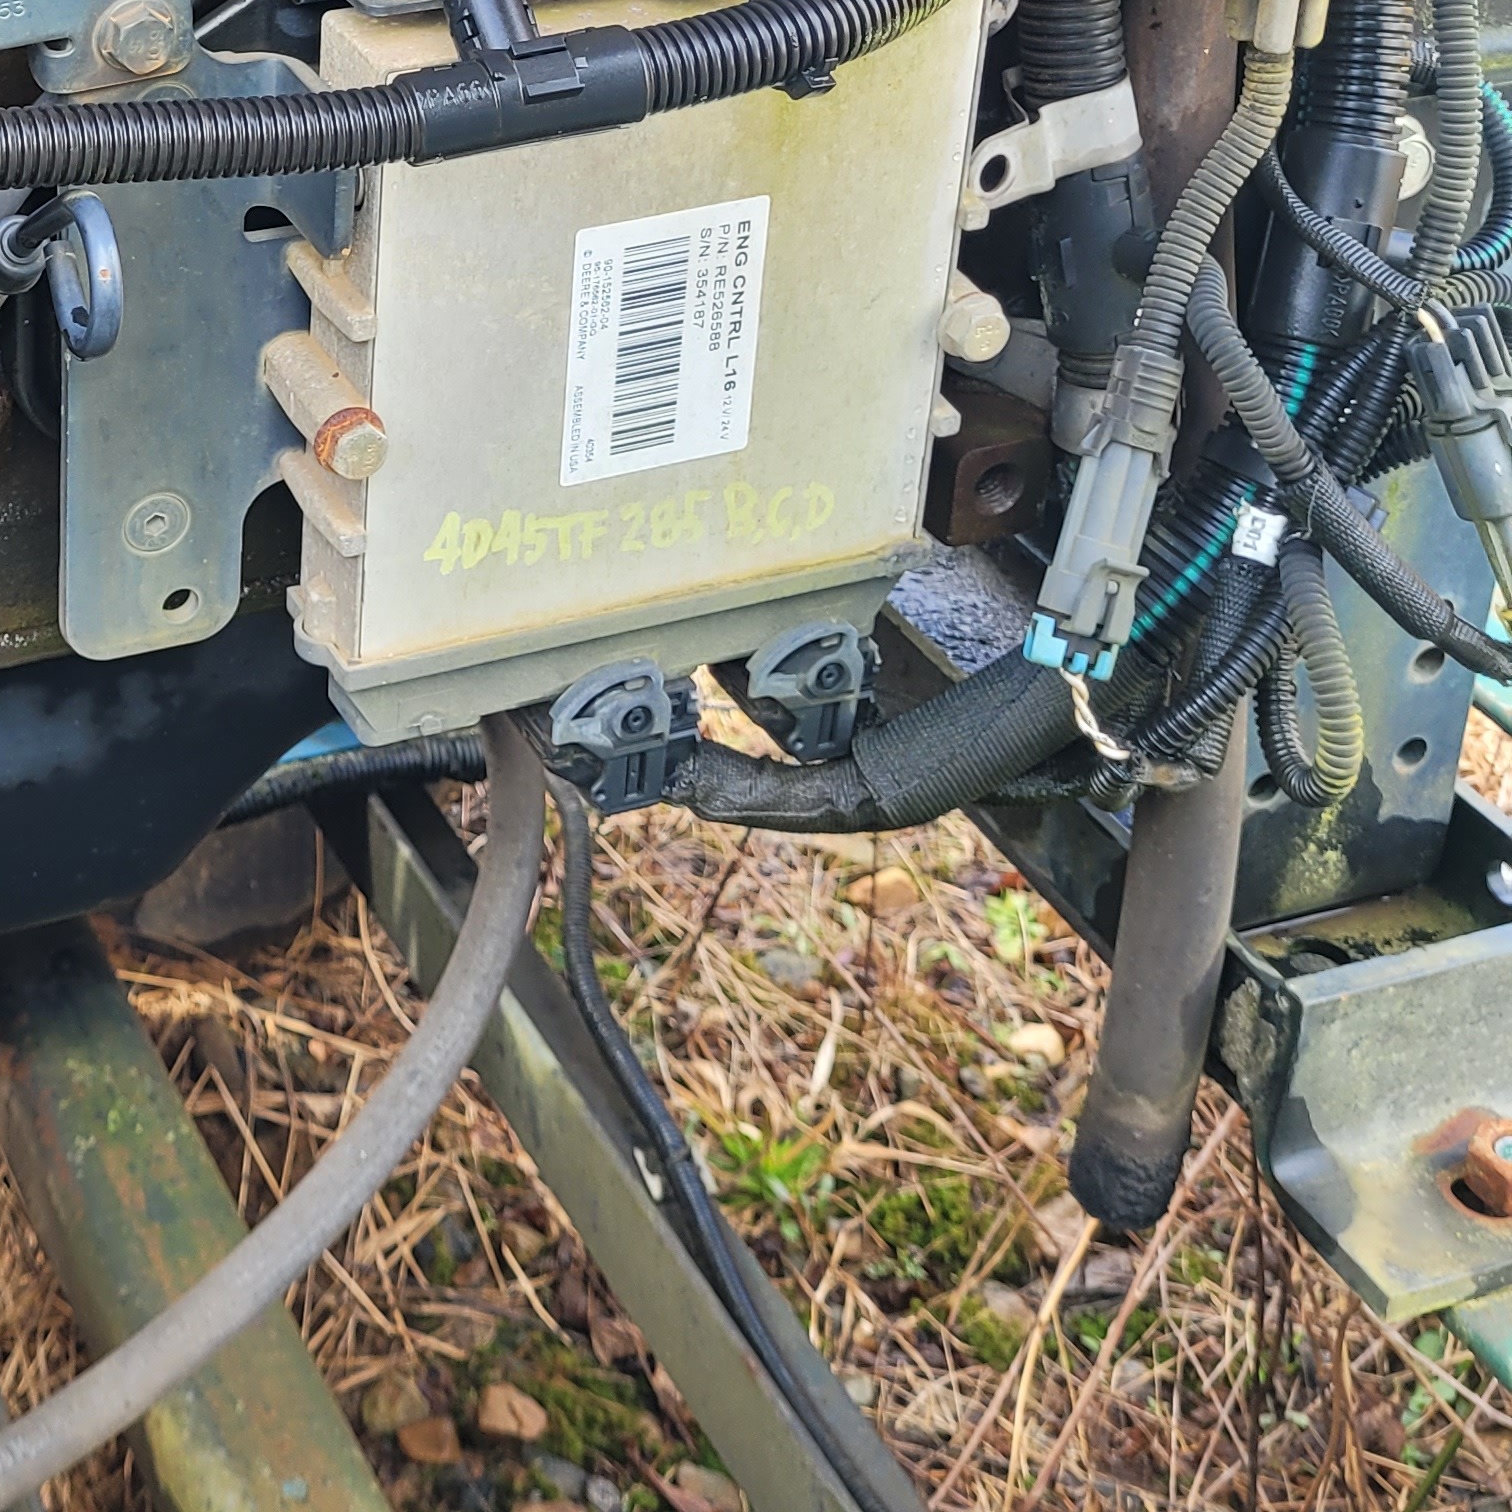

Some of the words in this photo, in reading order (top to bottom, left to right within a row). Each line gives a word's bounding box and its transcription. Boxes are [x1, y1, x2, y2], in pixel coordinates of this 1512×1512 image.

[696, 227, 713, 263] S/N:
[716, 223, 731, 260] P/N:
[734, 220, 751, 267] ENG
[580, 262, 592, 299] DEERE
[693, 268, 709, 329] 354187
[708, 265, 727, 351] RE526588
[727, 274, 747, 349] CNTRL
[575, 309, 589, 360] COMPANY
[723, 354, 740, 392] L16
[571, 385, 584, 442] ASSEMBLED
[568, 454, 580, 473] USA
[618, 489, 713, 552] 285
